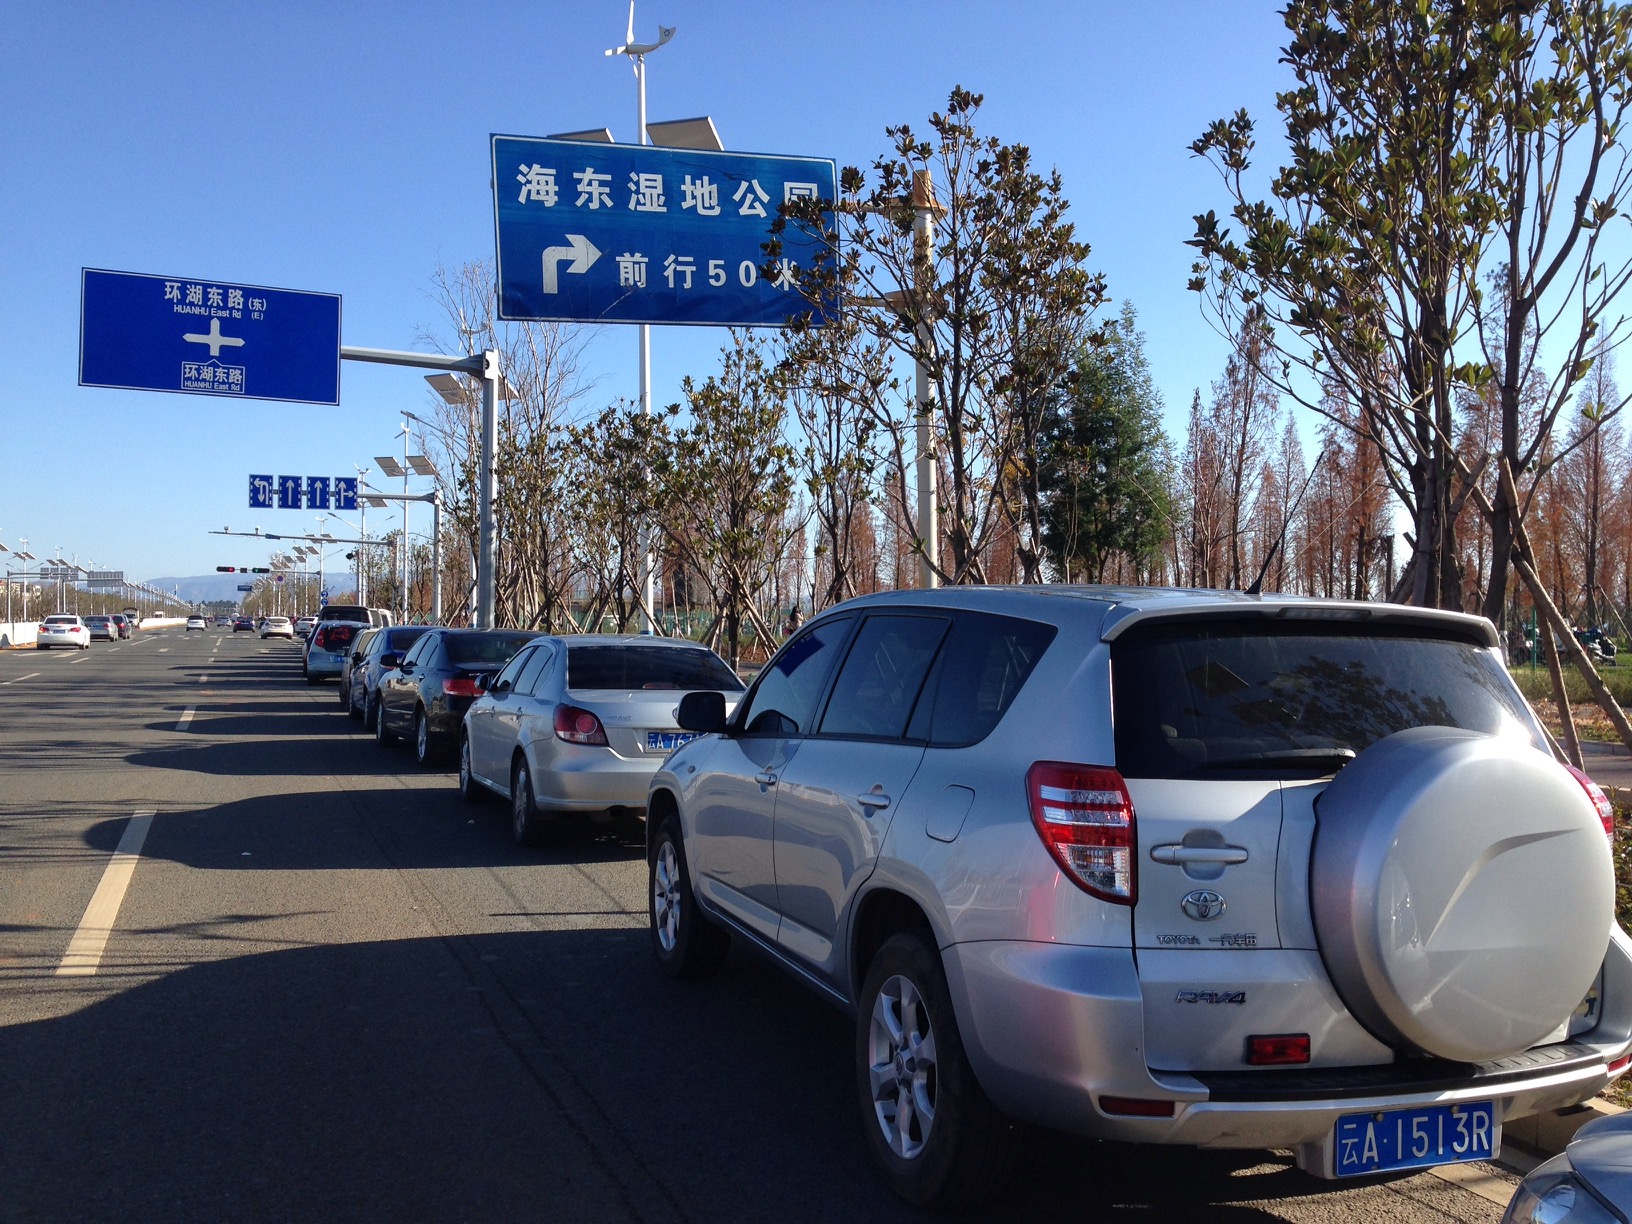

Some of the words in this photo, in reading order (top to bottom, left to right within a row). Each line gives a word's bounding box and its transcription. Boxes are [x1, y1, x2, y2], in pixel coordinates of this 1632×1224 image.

[615, 251, 802, 291] 前行50米
[164, 281, 244, 309] 环湖东路
[248, 297, 267, 311] (东)
[173, 304, 209, 316] HUANHU
[210, 308, 230, 318] East
[232, 309, 242, 319] Rd
[251, 312, 264, 320] (E)
[184, 364, 242, 384] 环湖东路
[184, 380, 212, 389] HUANHU
[214, 382, 229, 390] East
[1157, 934, 1201, 945] TOYOTA
[1176, 989, 1247, 1005] RAV4
